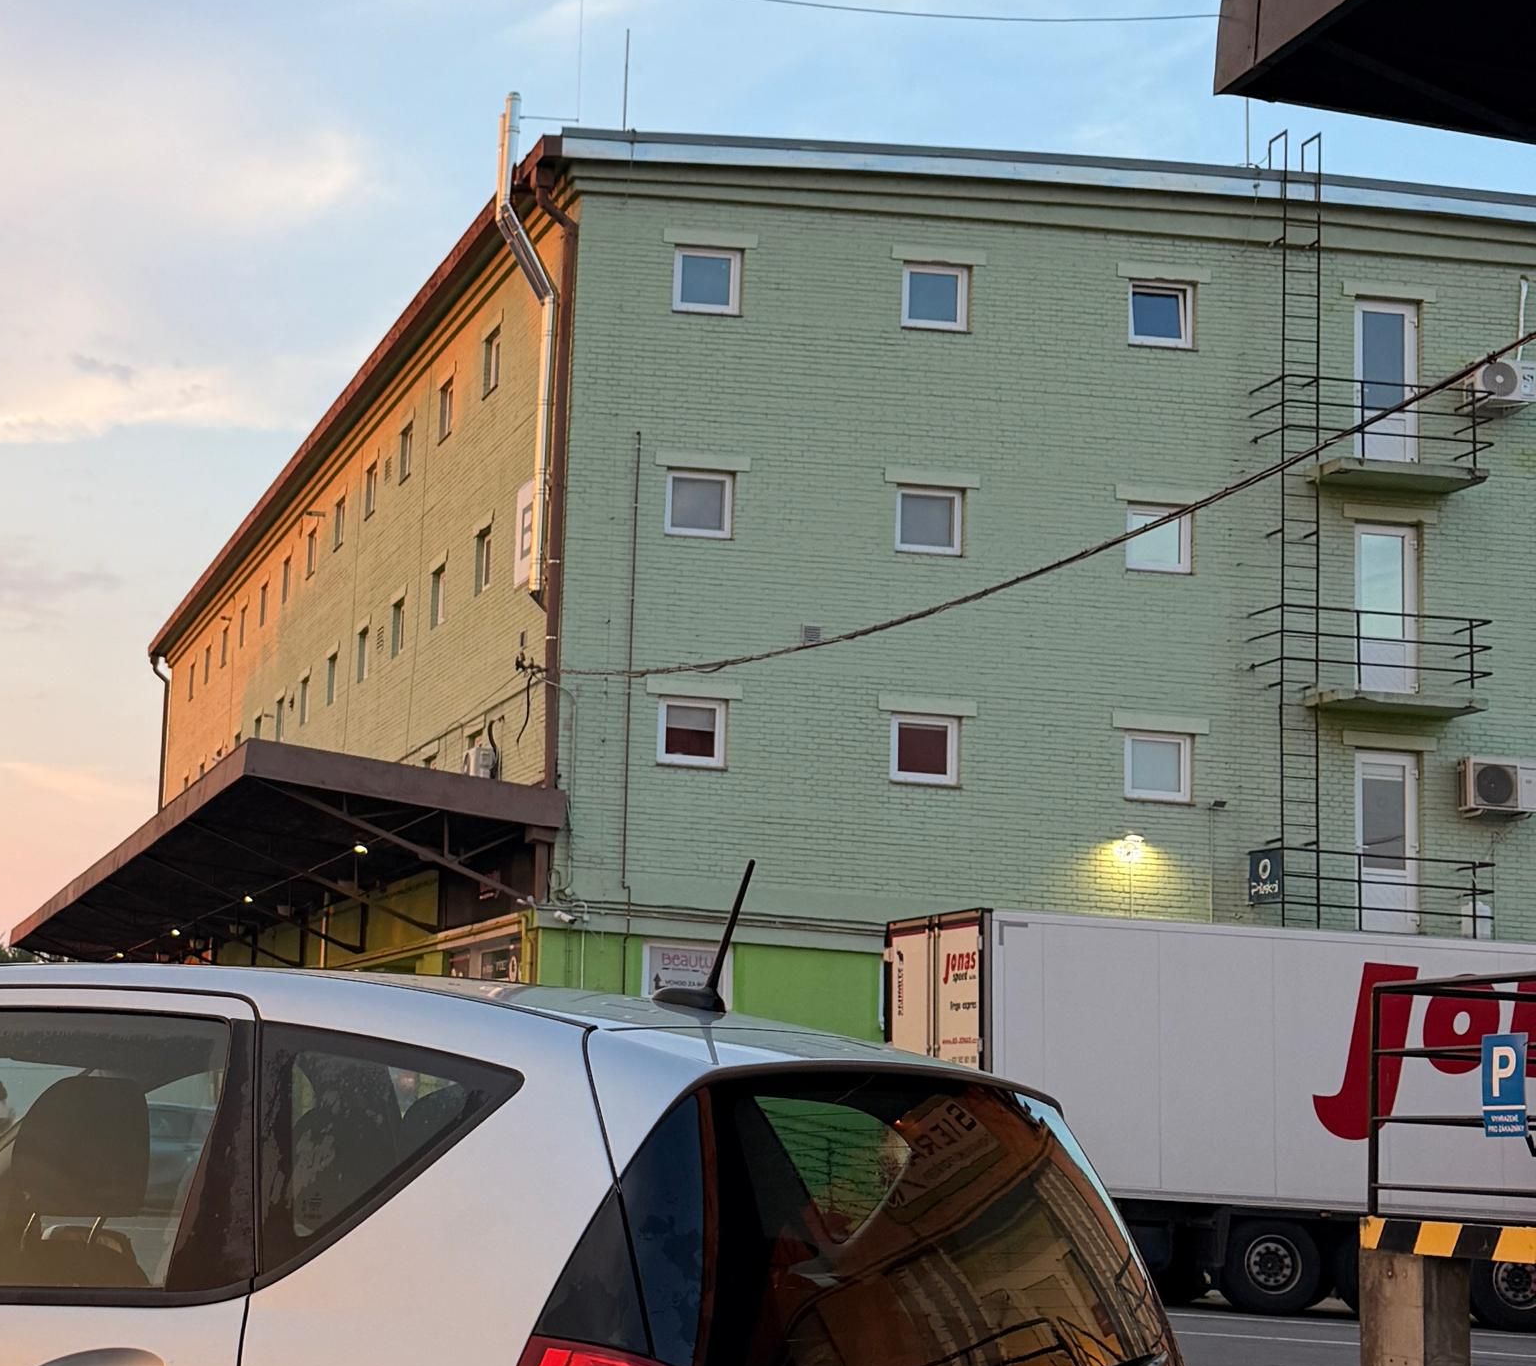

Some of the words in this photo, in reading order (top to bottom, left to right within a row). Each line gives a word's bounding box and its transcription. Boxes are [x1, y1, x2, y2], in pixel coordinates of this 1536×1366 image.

[943, 951, 976, 985] Jonas
[1313, 962, 1536, 1140] Jo
[1492, 1046, 1517, 1098] P
